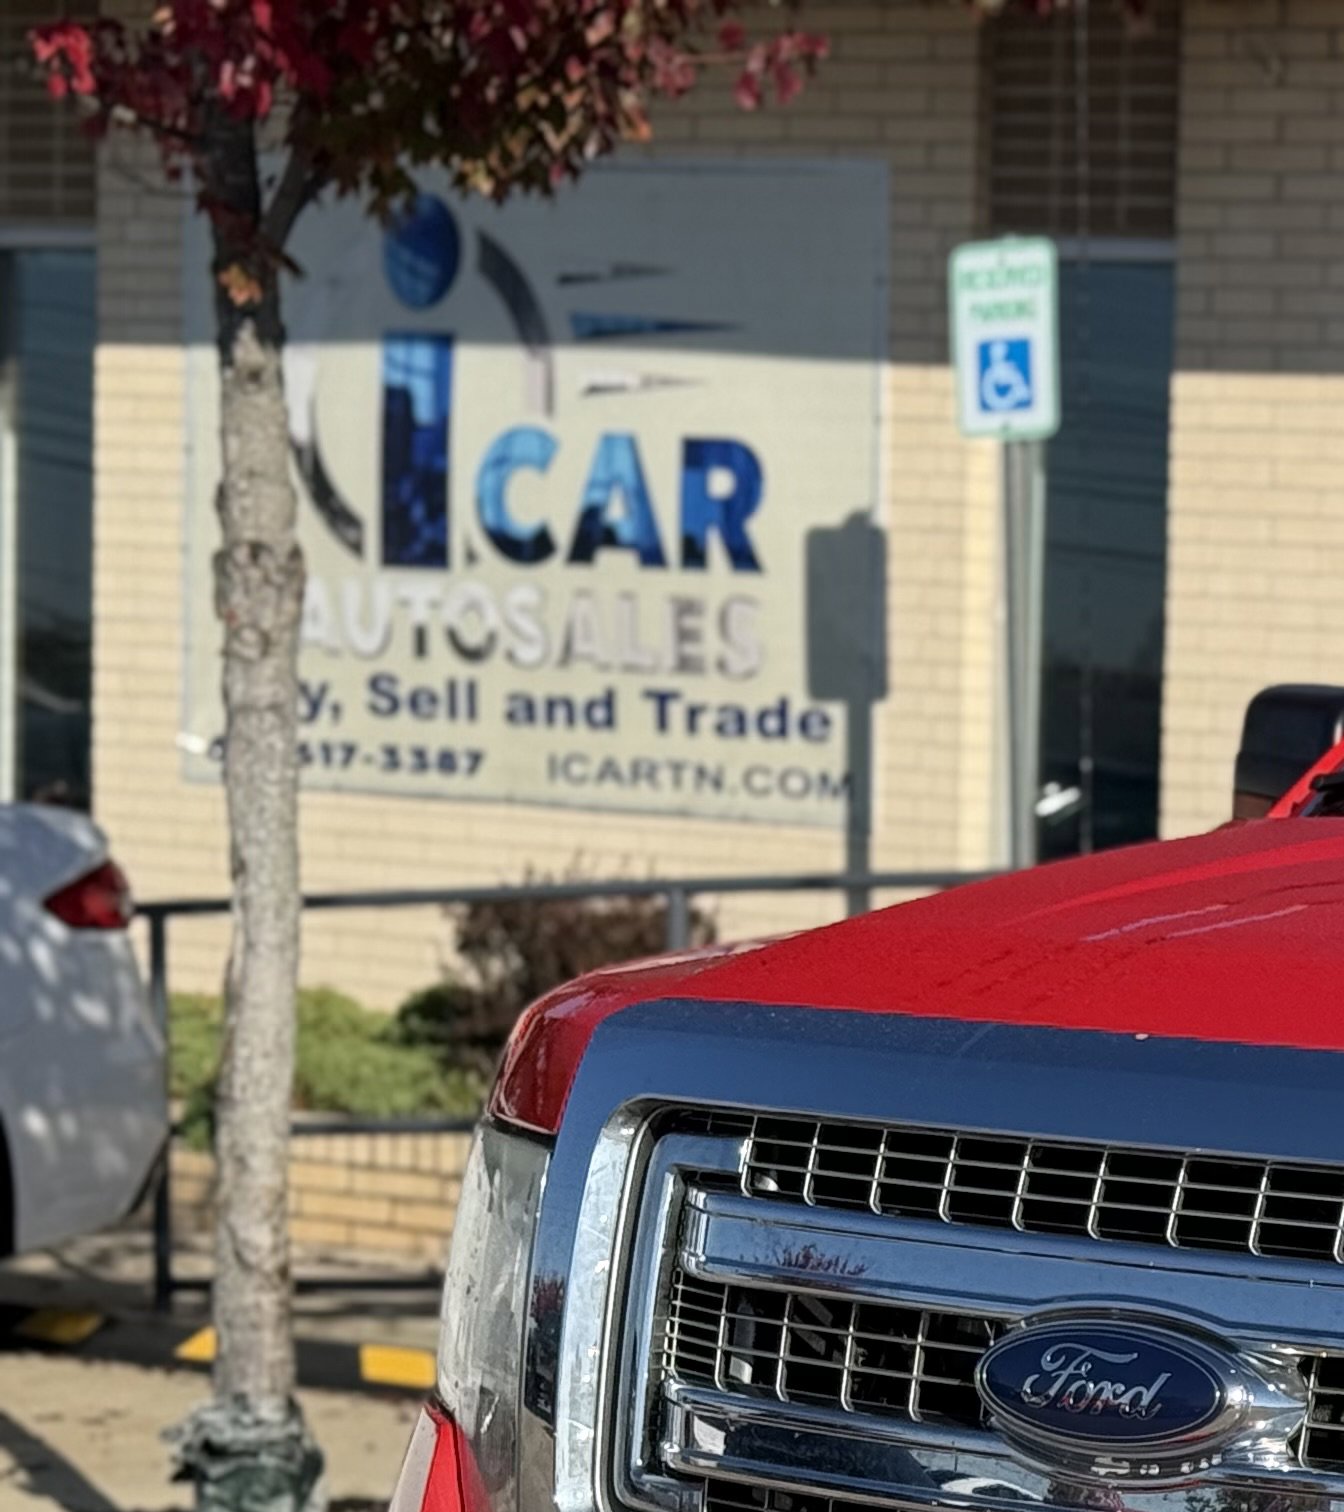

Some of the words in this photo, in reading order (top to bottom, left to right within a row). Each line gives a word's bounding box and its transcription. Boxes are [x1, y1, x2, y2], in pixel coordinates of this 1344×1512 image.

[368, 671, 479, 724] Sell
[505, 686, 616, 733] and
[642, 687, 832, 743] Trade
[547, 752, 855, 802] ICARTN.COM
[1020, 1341, 1172, 1421] Ford
